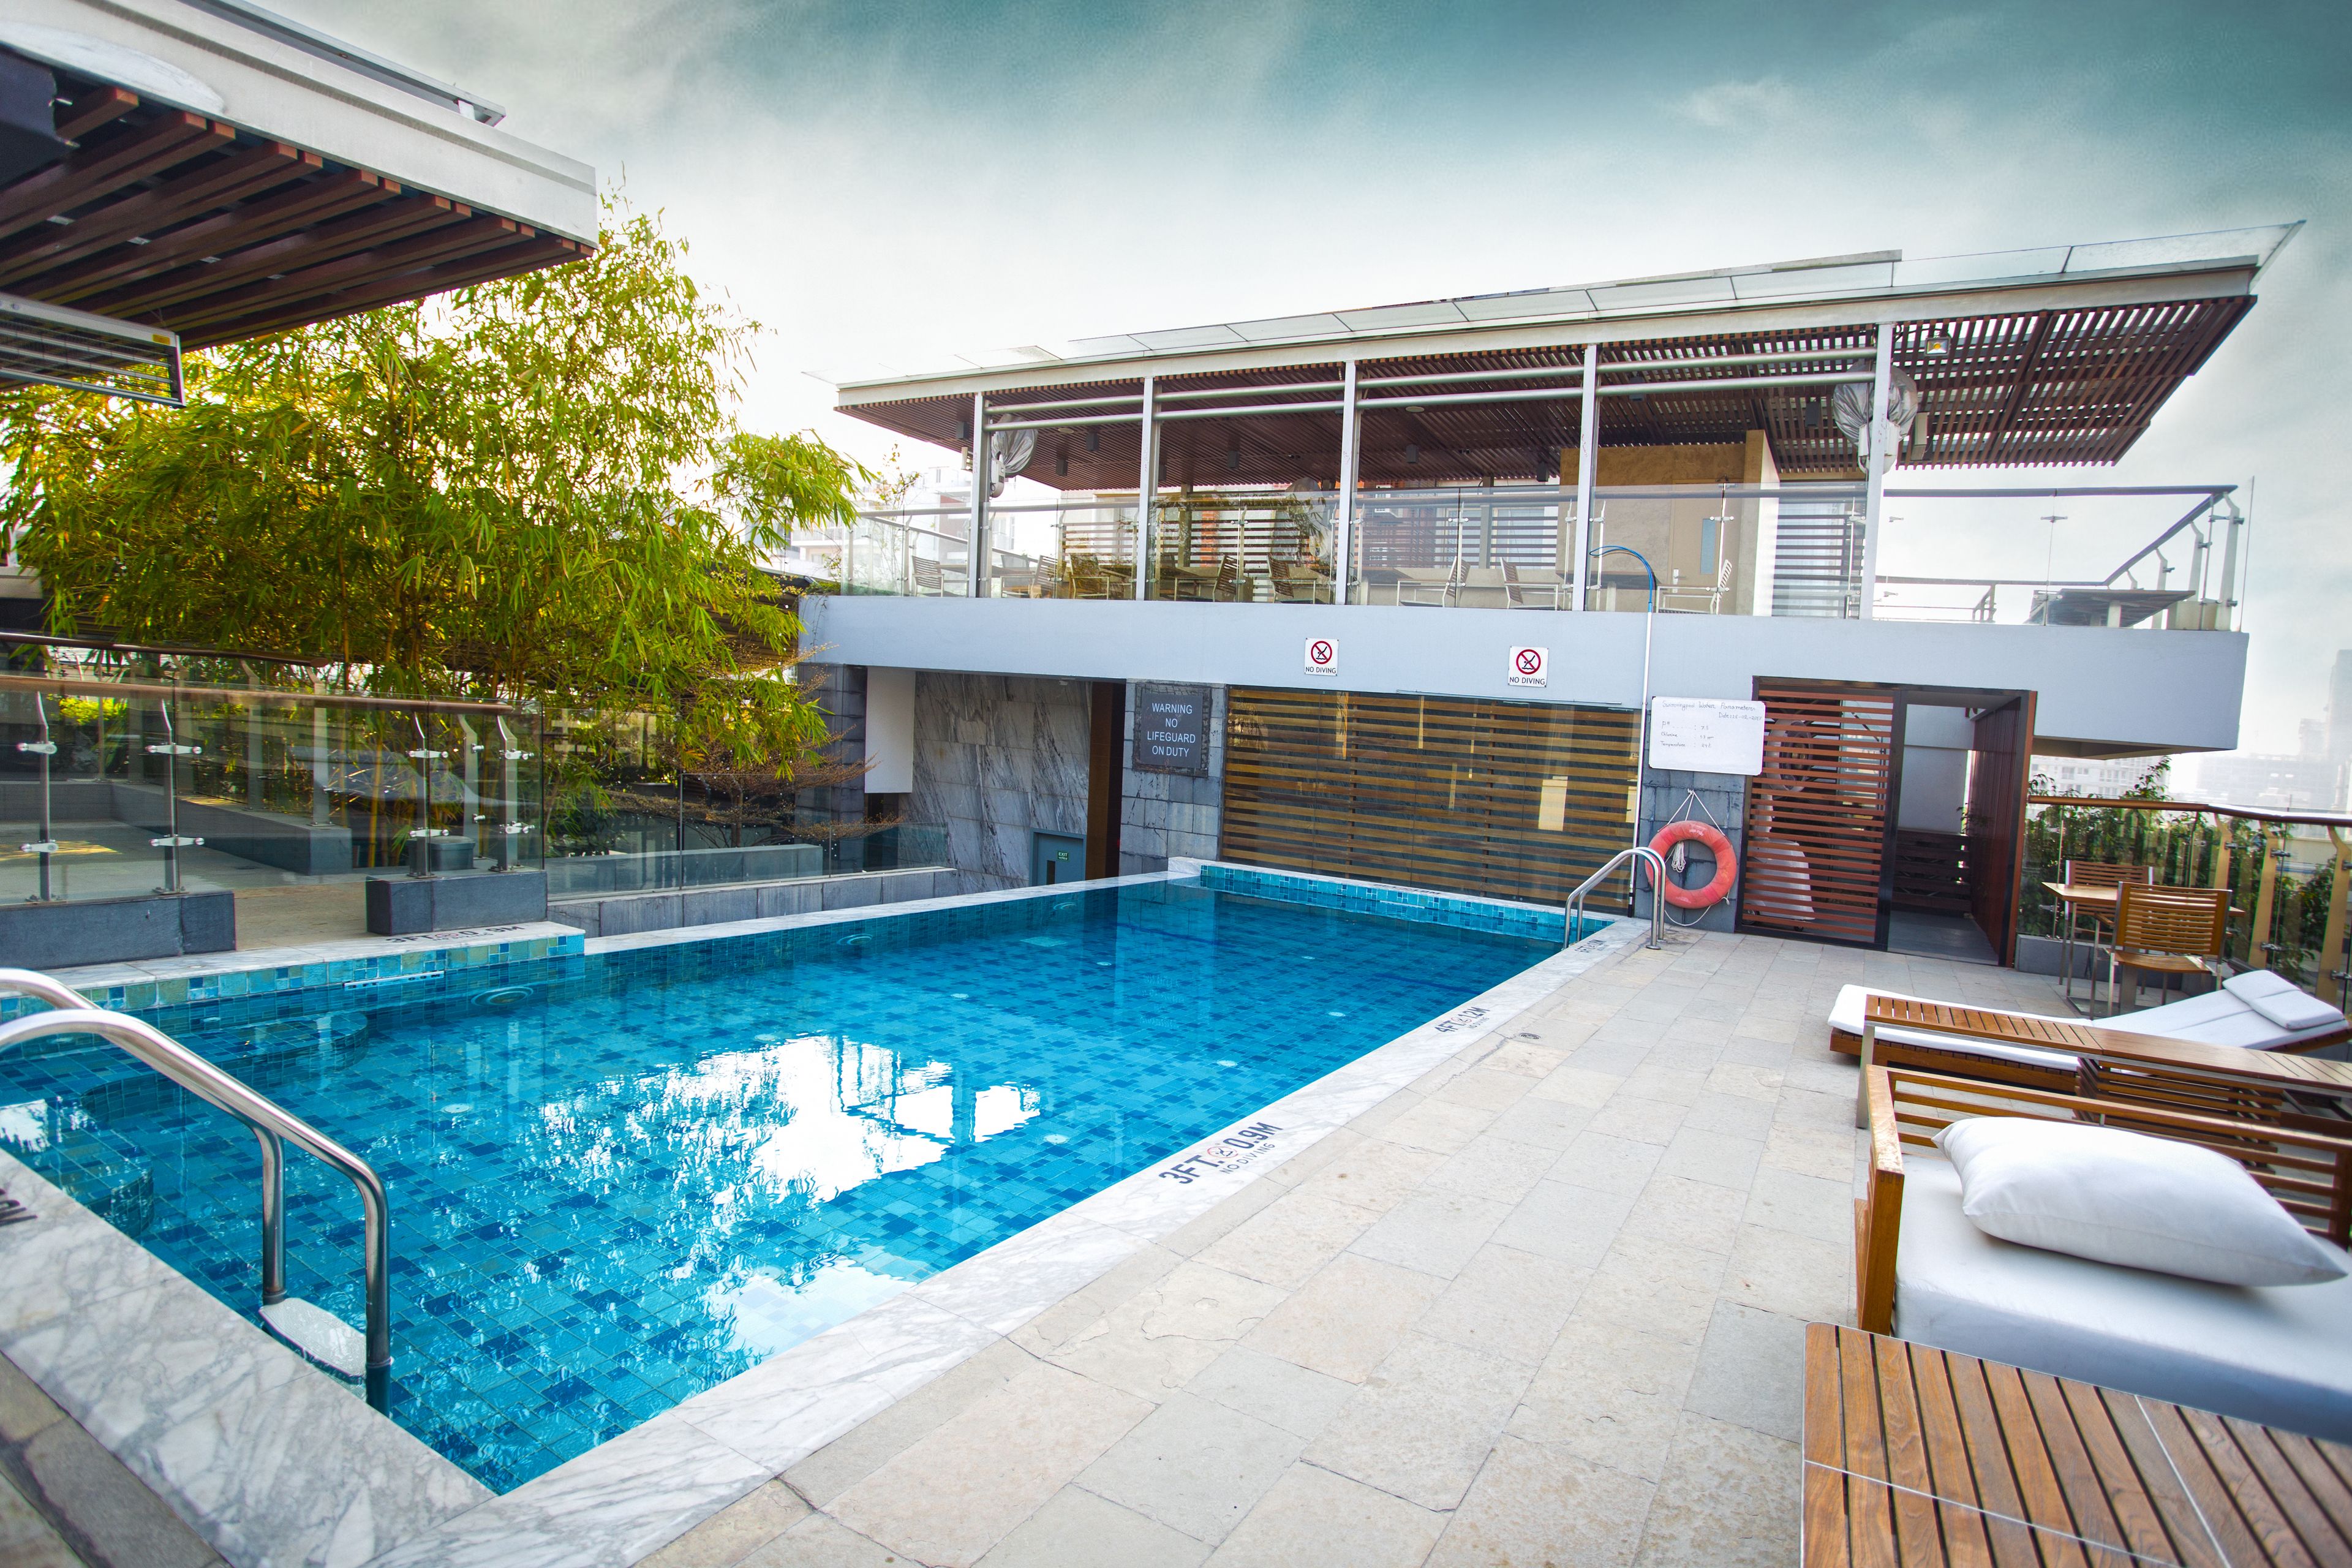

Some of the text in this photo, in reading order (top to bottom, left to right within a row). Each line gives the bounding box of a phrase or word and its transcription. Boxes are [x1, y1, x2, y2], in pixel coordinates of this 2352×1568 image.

[1152, 703, 1193, 714] WARNING
[1165, 718, 1178, 728] NO
[1147, 731, 1196, 744] LIFEGUARD
[1152, 745, 1189, 758] ON DUTY
[1223, 1121, 1284, 1149] 0.9M
[1219, 1142, 1276, 1174] NO DIVING
